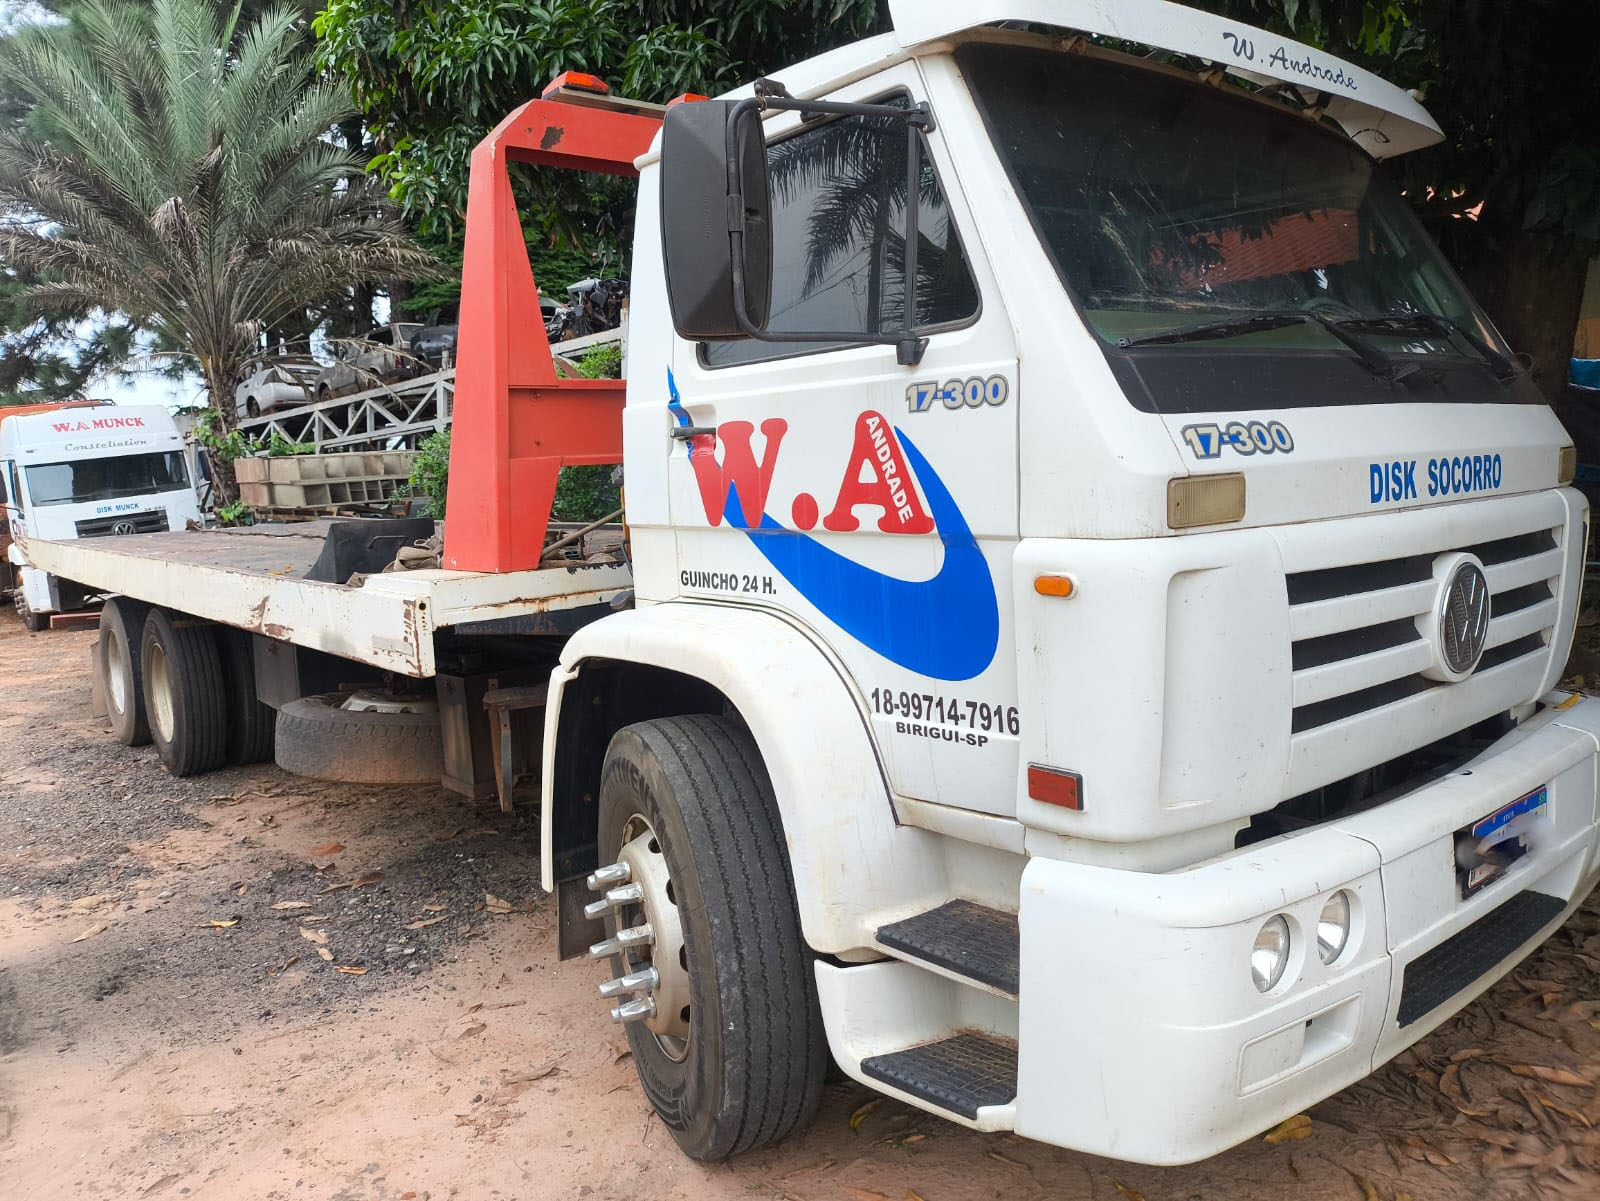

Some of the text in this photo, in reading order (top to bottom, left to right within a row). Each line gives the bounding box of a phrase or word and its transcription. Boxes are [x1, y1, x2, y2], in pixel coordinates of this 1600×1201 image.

[1269, 46, 1358, 91] Andrade
[92, 417, 145, 429] MUNCK
[865, 415, 914, 525] ANDRADE
[1369, 453, 1502, 504] DISK SOCORRO
[96, 506, 113, 514] DISK
[115, 503, 140, 512] MUNCK
[680, 570, 777, 594] GUINCHO 24 H.
[871, 687, 1019, 735] 18-99714-7916
[896, 721, 989, 748] BIRIGUI-SP
